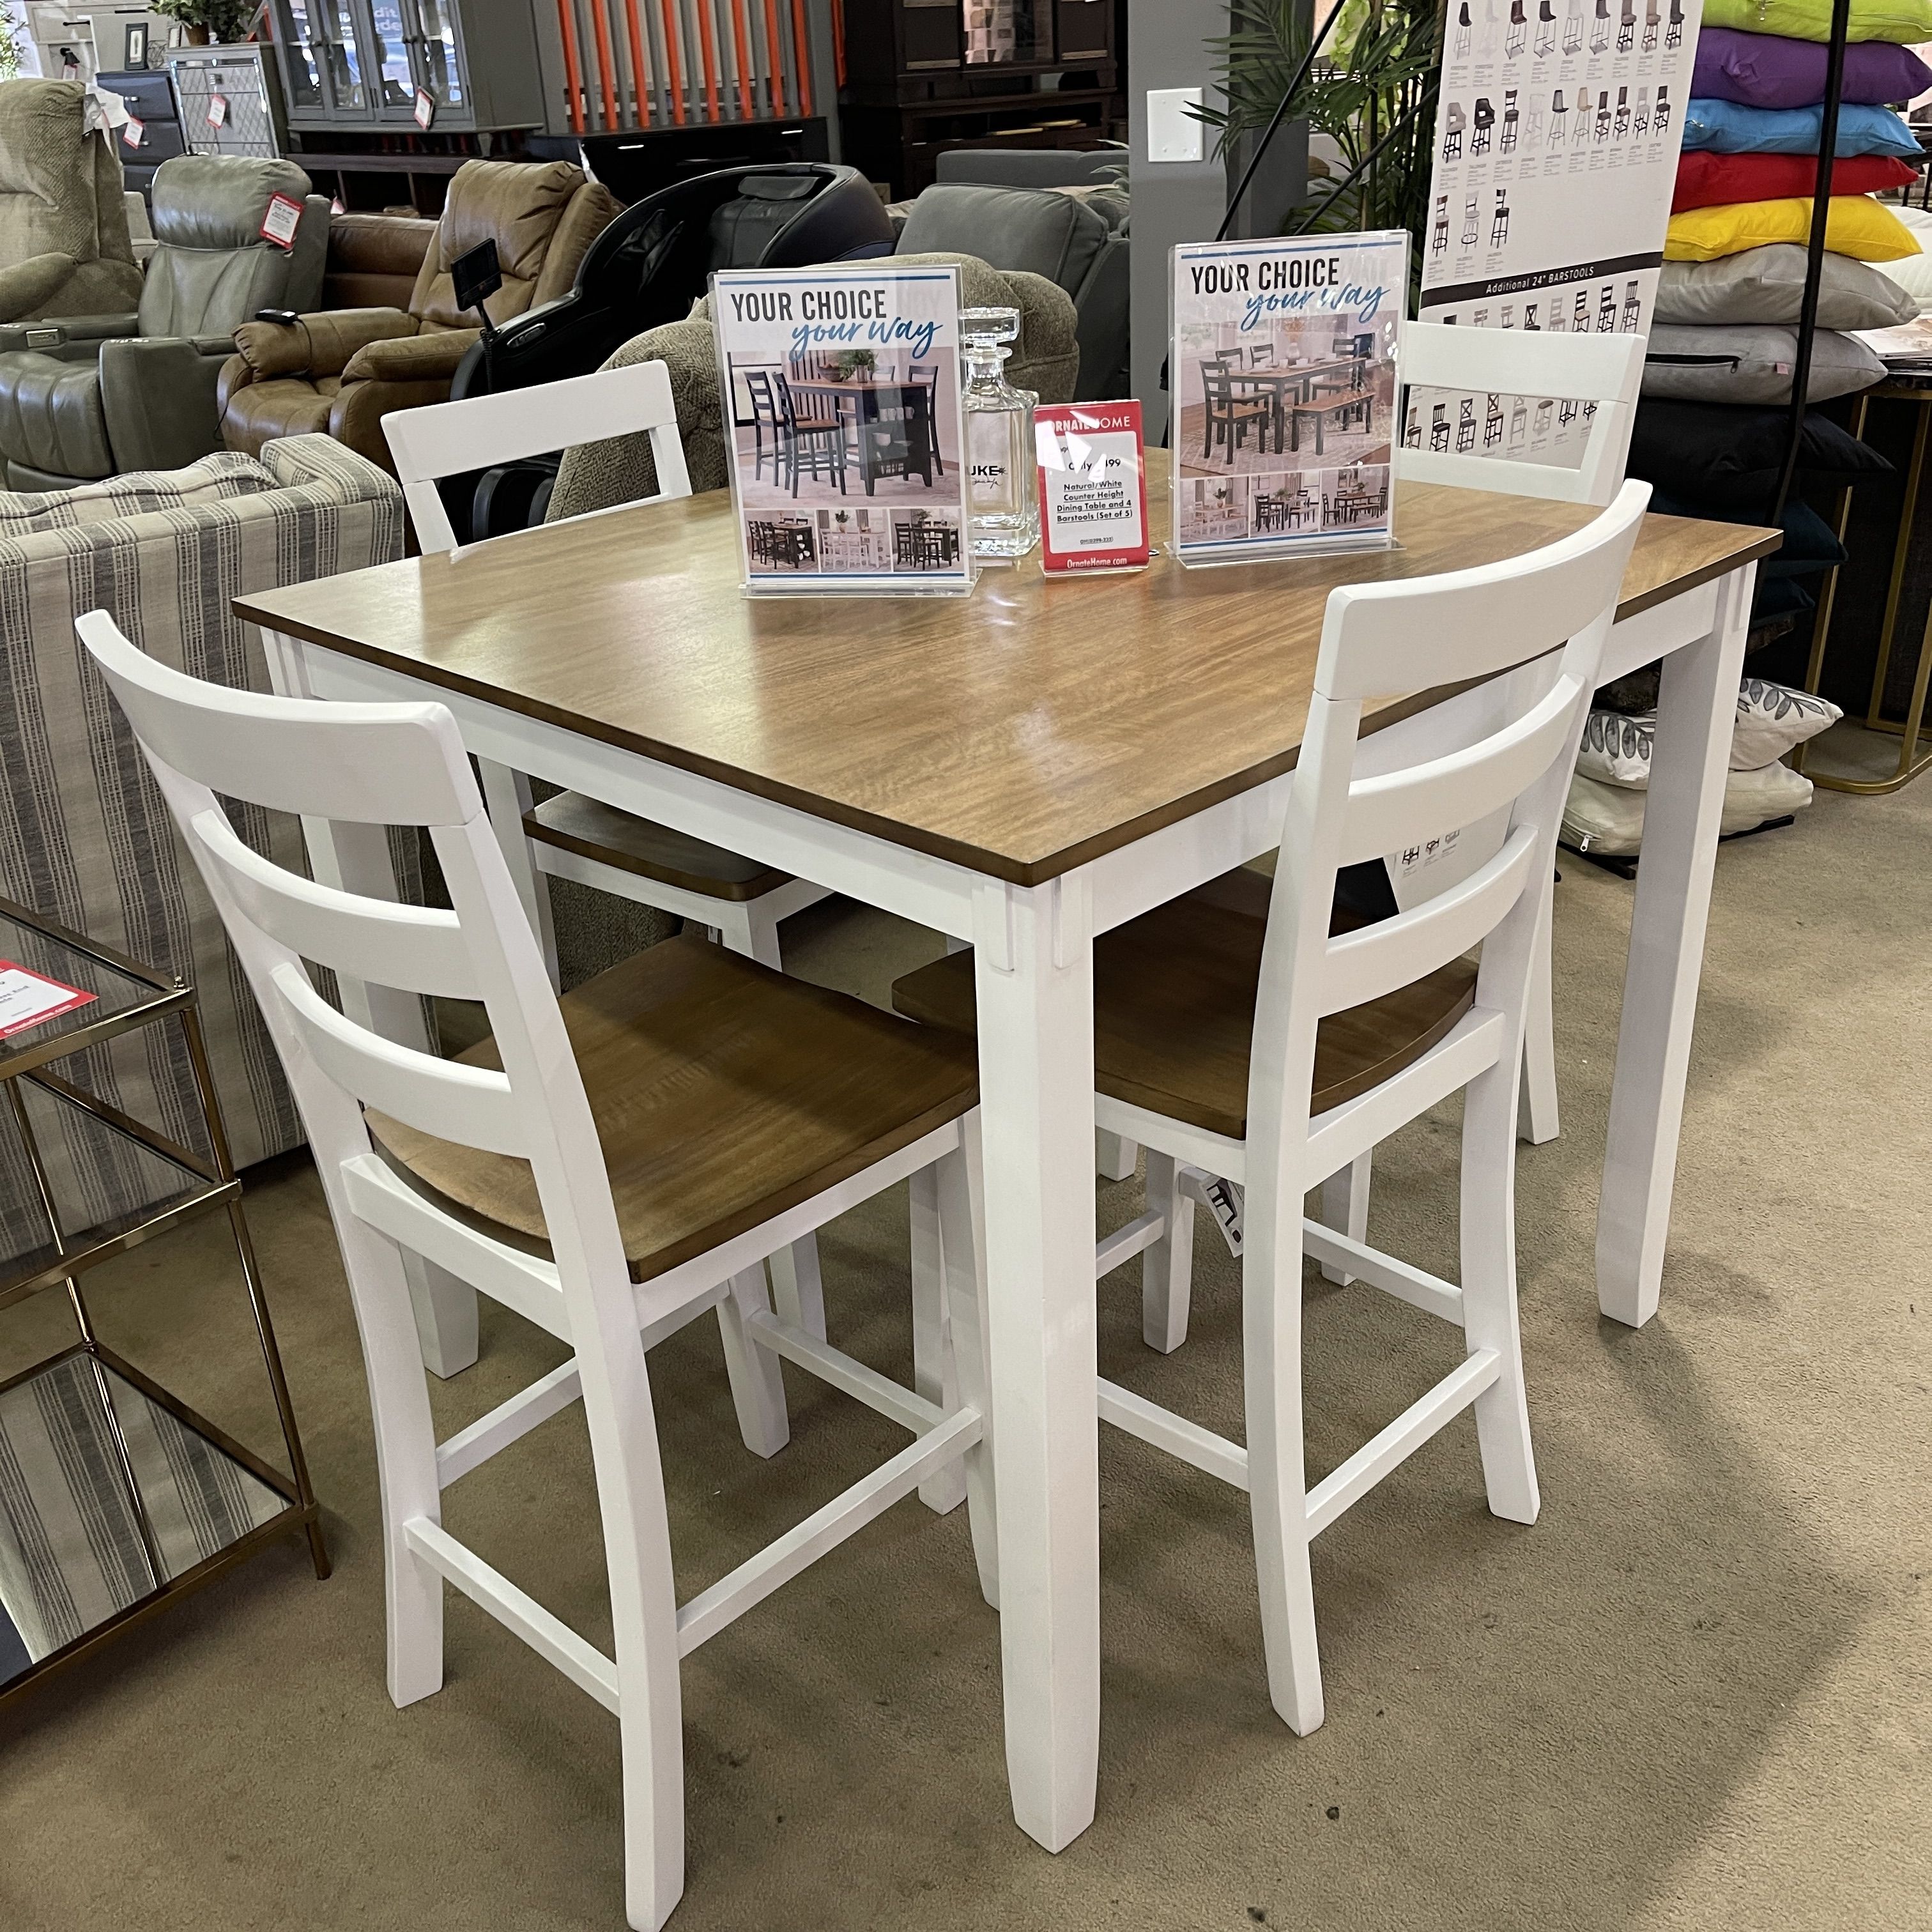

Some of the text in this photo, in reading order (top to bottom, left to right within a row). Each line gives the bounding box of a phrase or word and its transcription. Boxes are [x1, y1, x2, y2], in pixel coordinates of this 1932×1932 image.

[1191, 257, 1340, 295] YOUR CHOICE
[1485, 278, 1530, 294] Additional
[1548, 266, 1595, 283] BARSTOOLS
[730, 289, 887, 321] YOUR CHOICE
[1240, 291, 1315, 332] your
[788, 323, 864, 362] your
[1095, 416, 1130, 429] OME
[1068, 460, 1092, 471] Oly
[1064, 489, 1124, 502] Counter Height
[1057, 503, 1082, 512] Dining
[1108, 500, 1124, 508] and
[1057, 512, 1094, 522] Barstools
[1096, 511, 1112, 520] (Set
